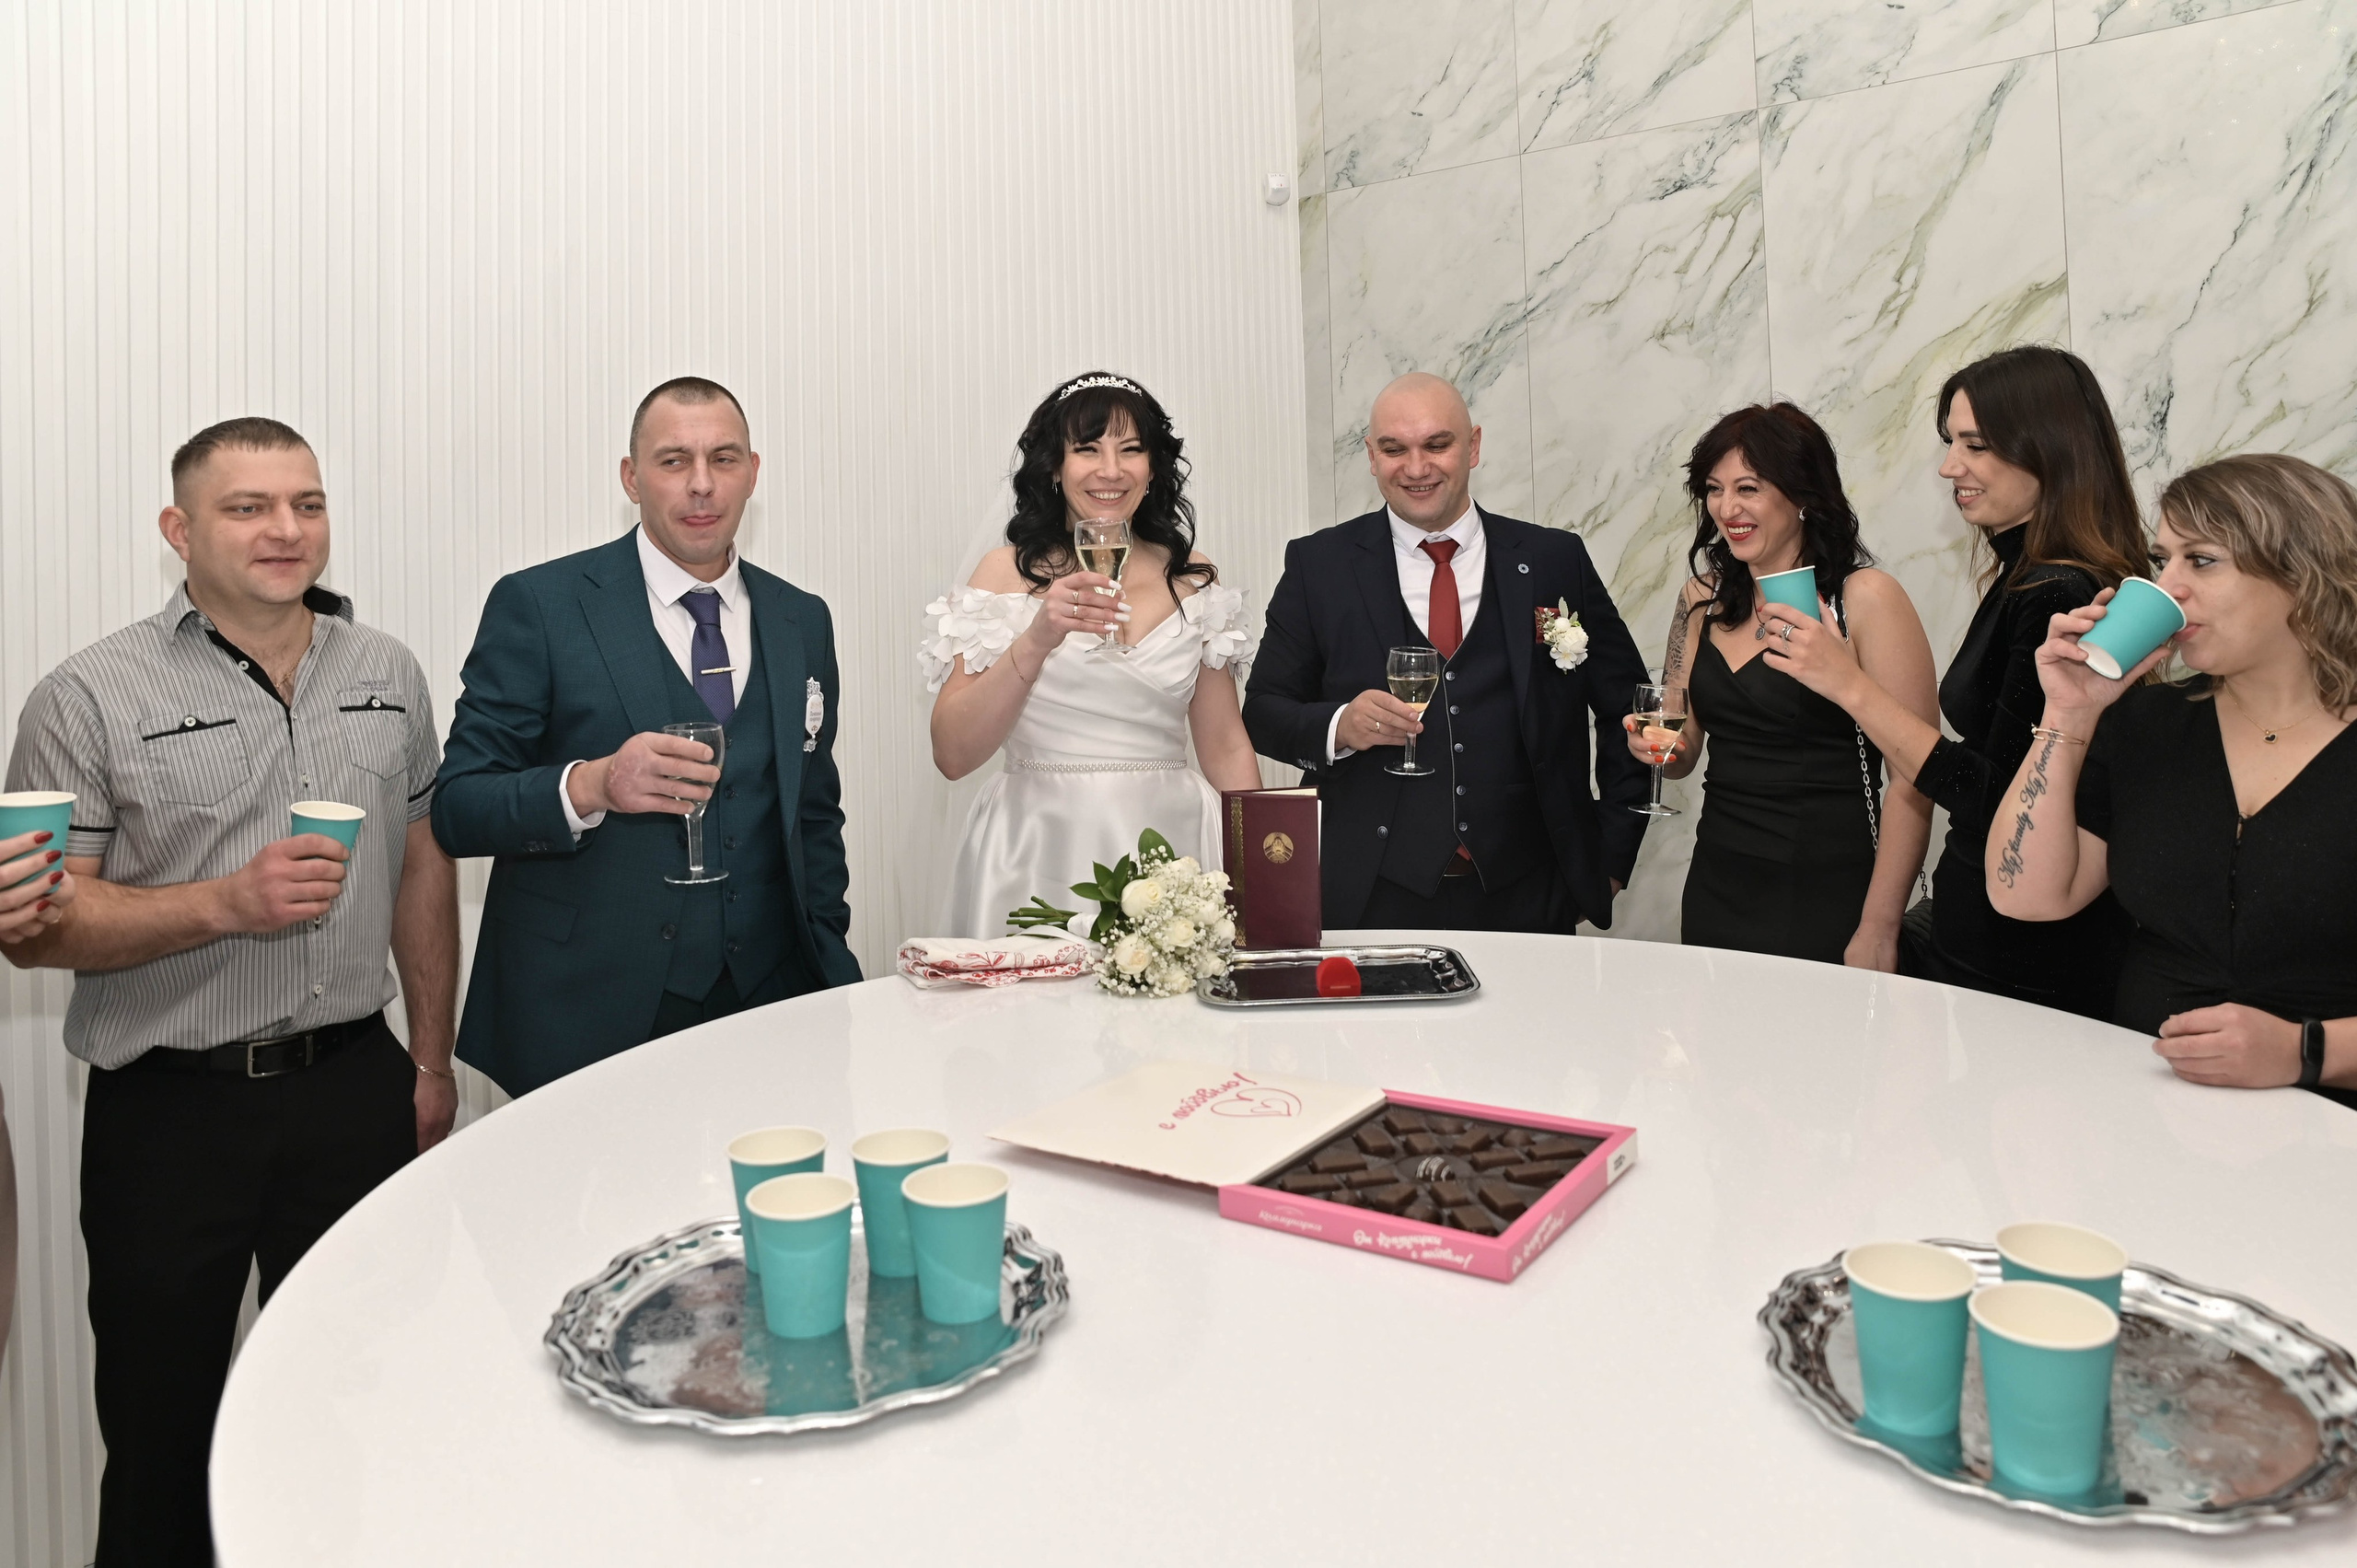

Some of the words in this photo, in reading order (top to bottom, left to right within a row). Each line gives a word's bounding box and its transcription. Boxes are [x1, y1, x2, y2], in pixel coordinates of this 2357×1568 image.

[2020, 770, 2046, 809] My
[2008, 811, 2035, 865] family
[1997, 847, 2023, 889] My
